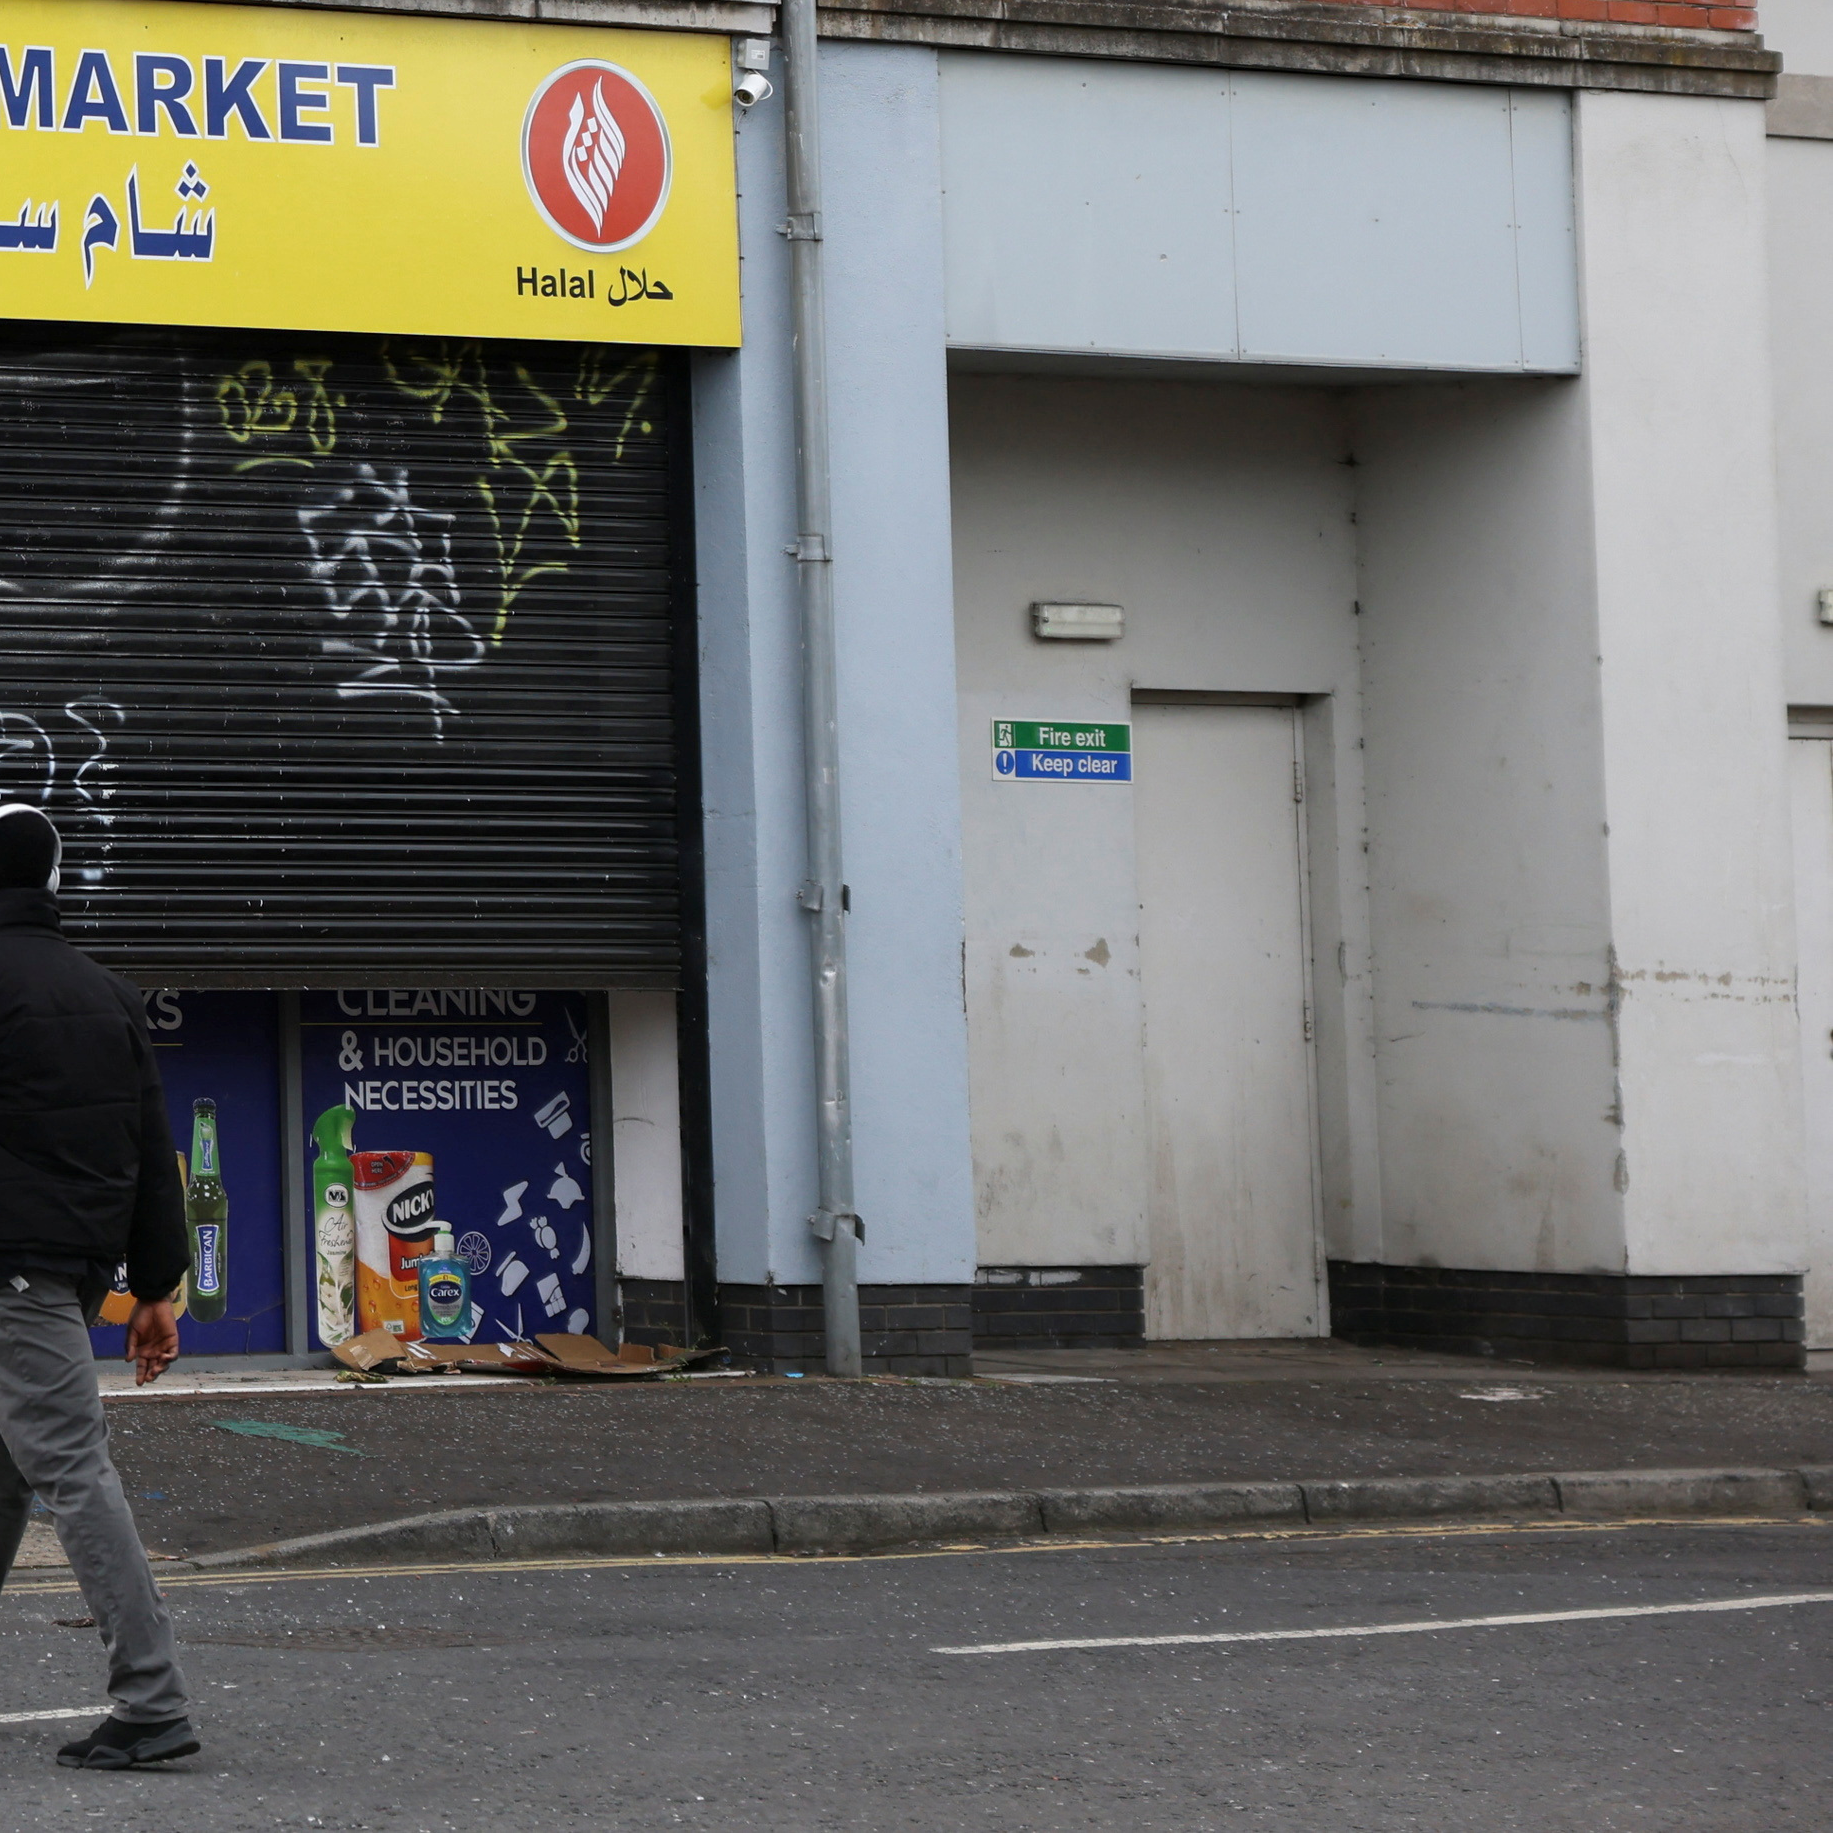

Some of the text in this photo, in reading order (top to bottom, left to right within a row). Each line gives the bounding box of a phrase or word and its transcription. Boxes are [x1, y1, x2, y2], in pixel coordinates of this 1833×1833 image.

[83, 159, 216, 290] شام
[517, 266, 595, 299] Halal
[608, 265, 673, 307] حلال
[1039, 727, 1106, 747] Fire exit
[1033, 754, 1118, 777] Keep clear
[337, 990, 536, 1016] CLEANING
[339, 1031, 547, 1071] & HOUSEHOLD
[345, 1080, 518, 1110] NECESSITIES
[202, 1229, 214, 1287] BARBICAN
[431, 1288, 460, 1297] Carex
